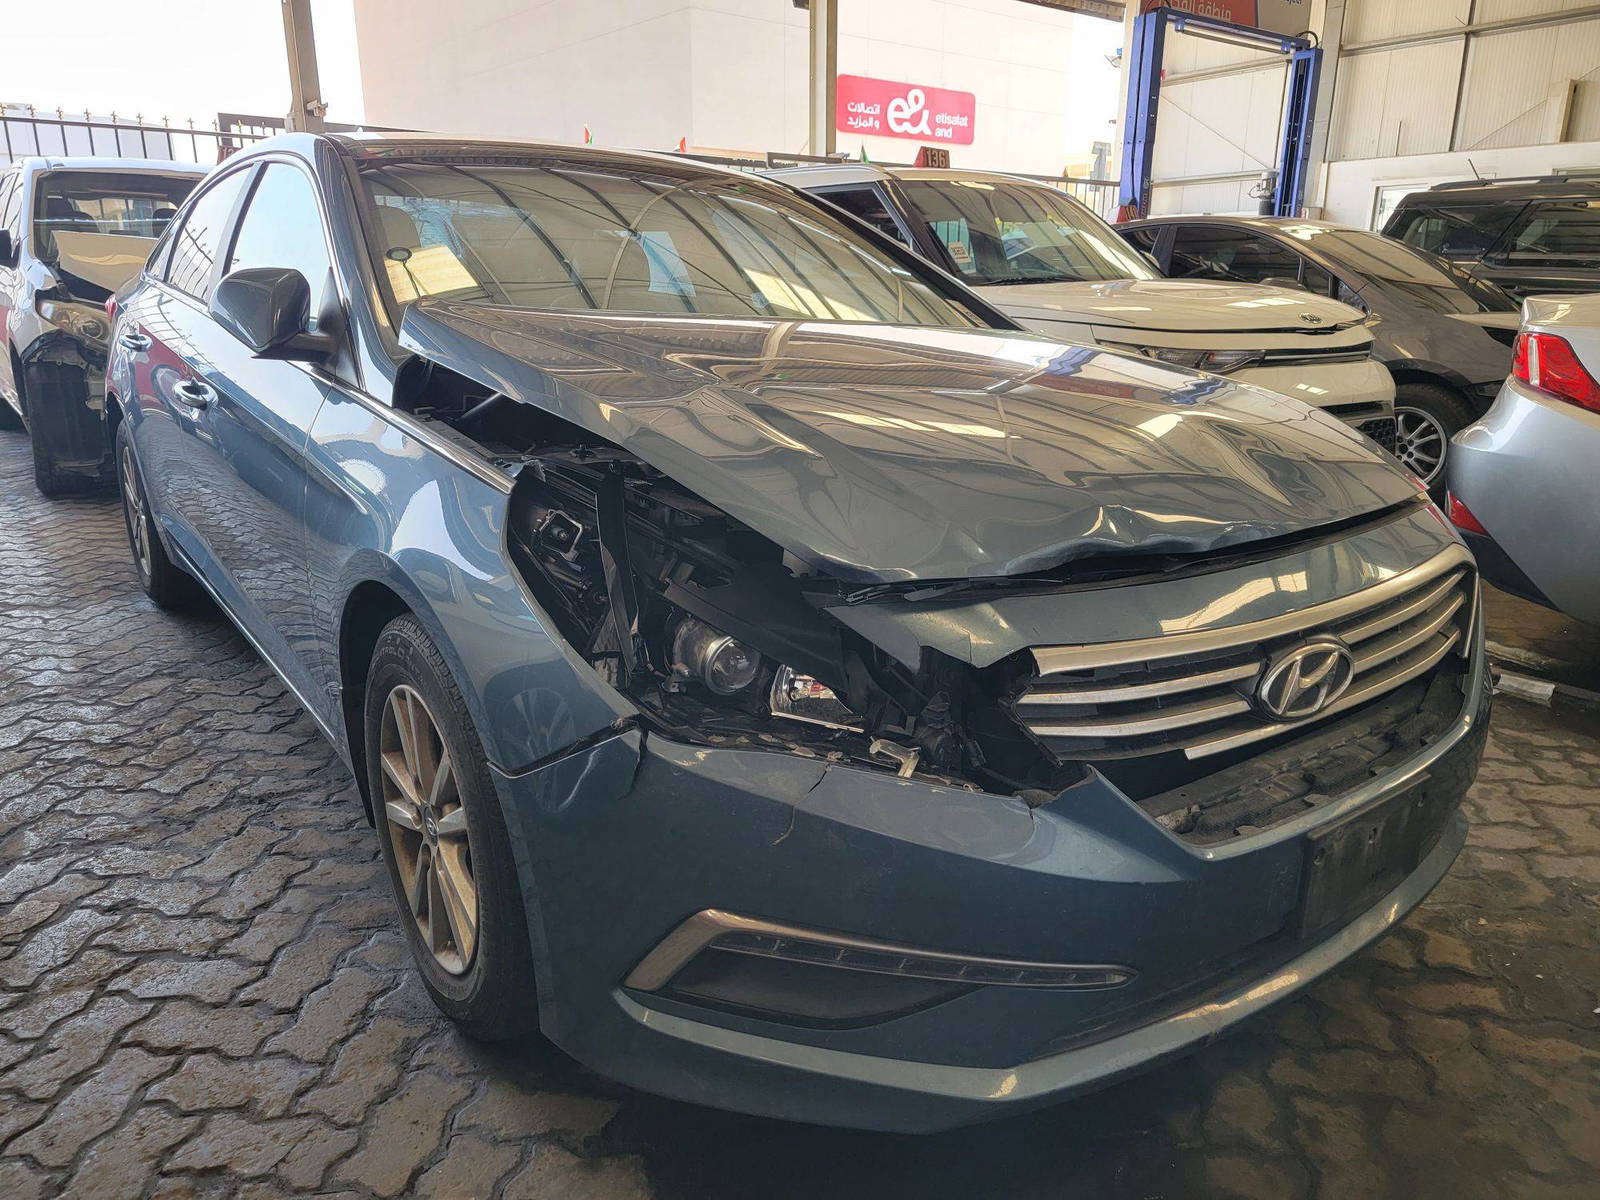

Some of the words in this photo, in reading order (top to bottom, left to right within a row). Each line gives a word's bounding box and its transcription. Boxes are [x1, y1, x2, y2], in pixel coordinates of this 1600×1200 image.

[935, 112, 969, 127] etisalat
[935, 126, 953, 139] and
[926, 148, 946, 167] 136
